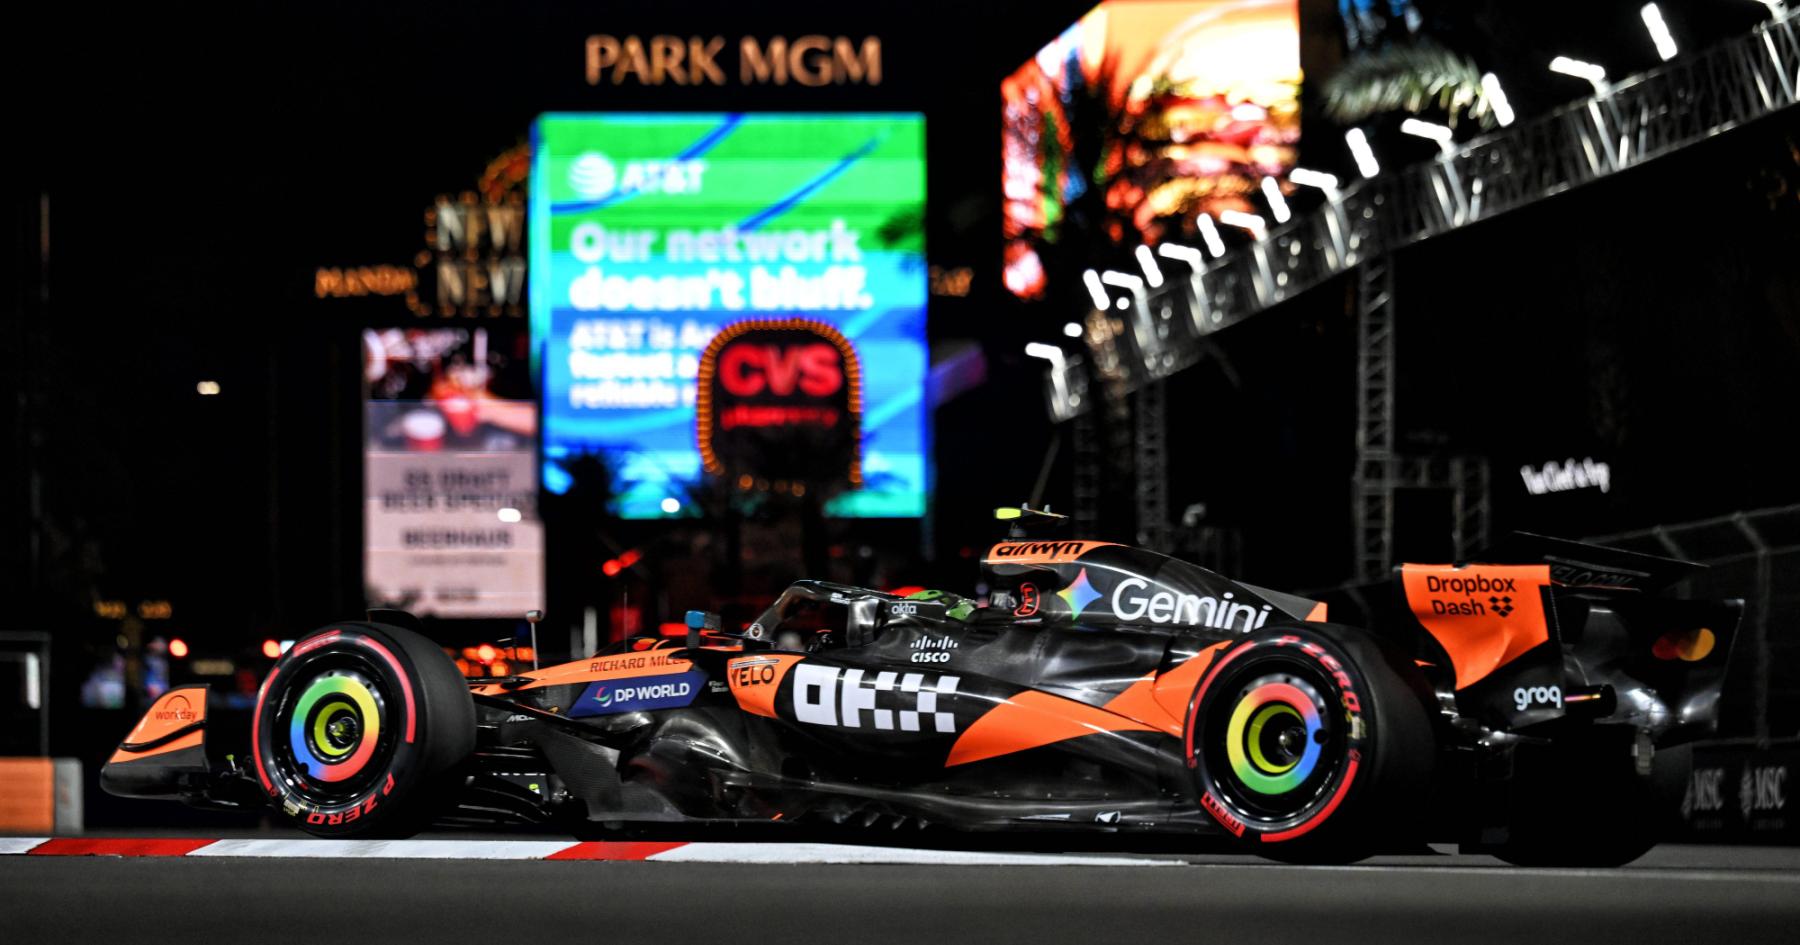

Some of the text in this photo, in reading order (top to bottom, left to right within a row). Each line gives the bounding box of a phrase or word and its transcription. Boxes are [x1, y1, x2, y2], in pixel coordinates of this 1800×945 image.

[585, 35, 882, 86] PARK MGM
[621, 160, 708, 195] AT&T
[571, 219, 862, 264] Our network
[569, 265, 745, 311] doesn't
[750, 265, 874, 311] bluff.
[719, 343, 843, 397] CVS
[996, 541, 1083, 559] allwyn
[1426, 575, 1518, 595] Dropbox
[890, 603, 917, 616] okta
[1111, 578, 1273, 634] Gemini
[1432, 599, 1486, 616] Dash
[590, 657, 646, 673] RICHARD
[731, 664, 775, 687] VELO
[614, 688, 635, 703] DP
[636, 682, 690, 701] WORLD
[792, 663, 960, 733] OKX
[1513, 684, 1562, 712] groq
[155, 707, 199, 723] workday
[383, 772, 396, 797] P
[306, 793, 379, 825] ZERO
